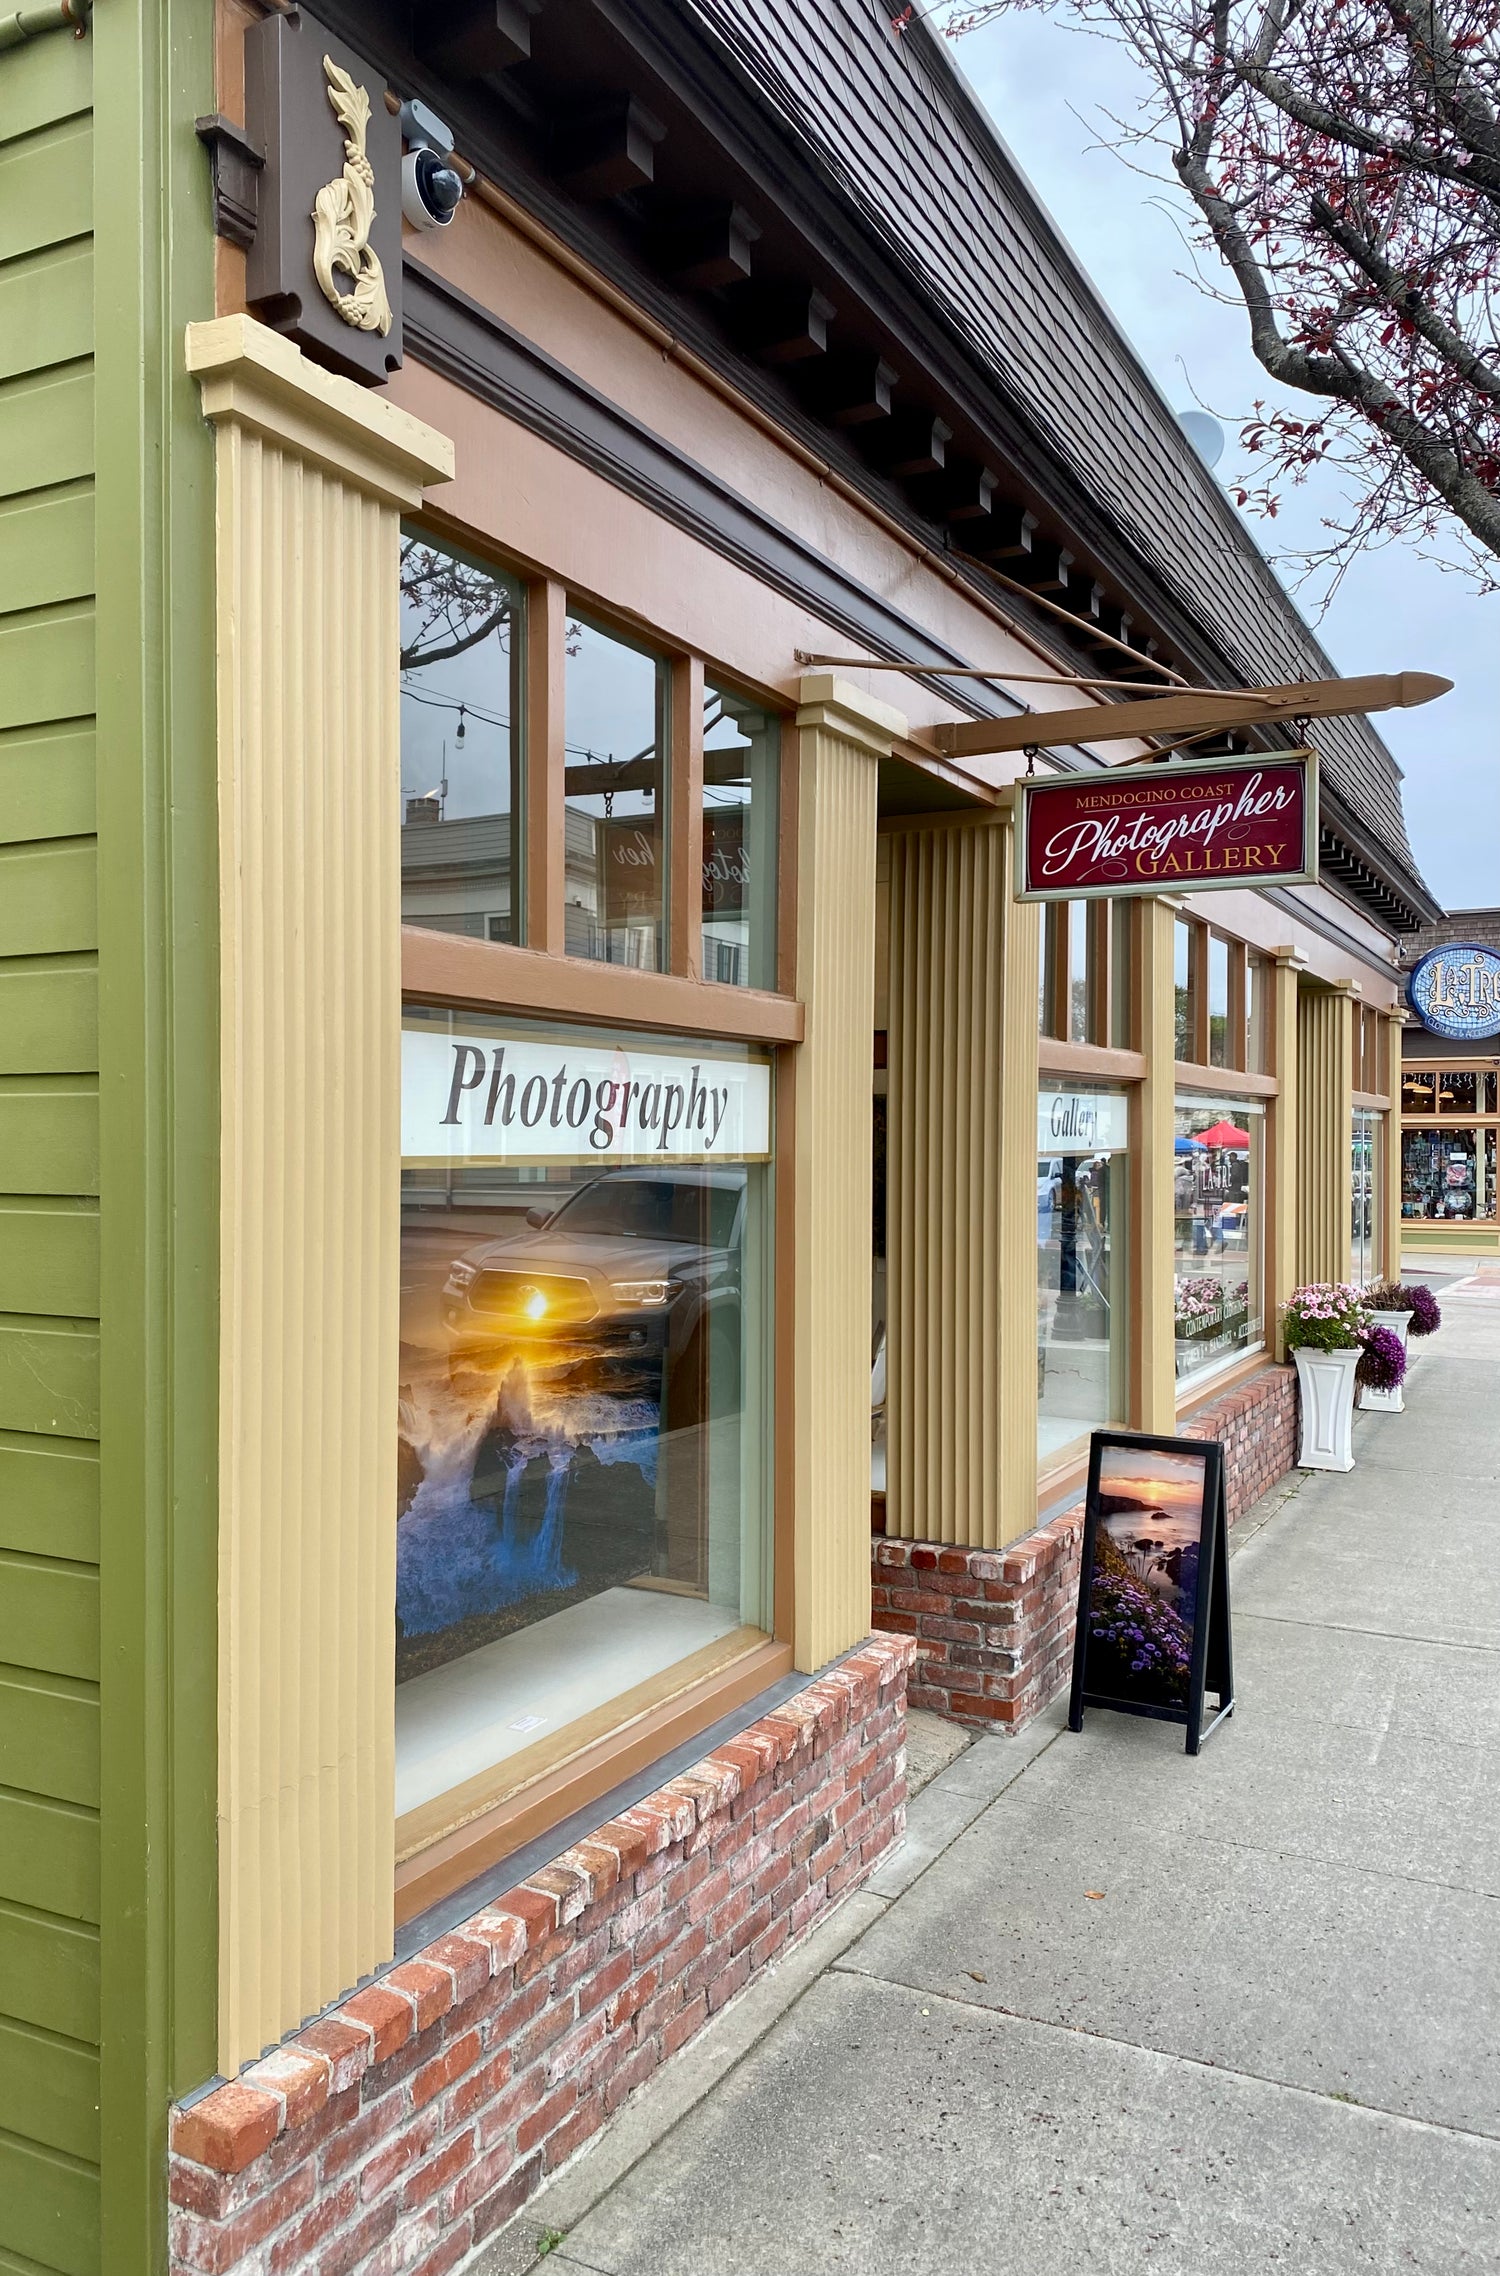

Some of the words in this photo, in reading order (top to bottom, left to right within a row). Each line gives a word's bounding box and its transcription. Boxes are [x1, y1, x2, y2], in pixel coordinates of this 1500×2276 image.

[1075, 789, 1176, 809] MENDOCINO
[1180, 783, 1235, 799] COAST
[1042, 772, 1297, 876] Photographer
[1135, 843, 1288, 876] GALLERY
[438, 1044, 728, 1150] Photography
[1050, 1096, 1097, 1147] Gallery
